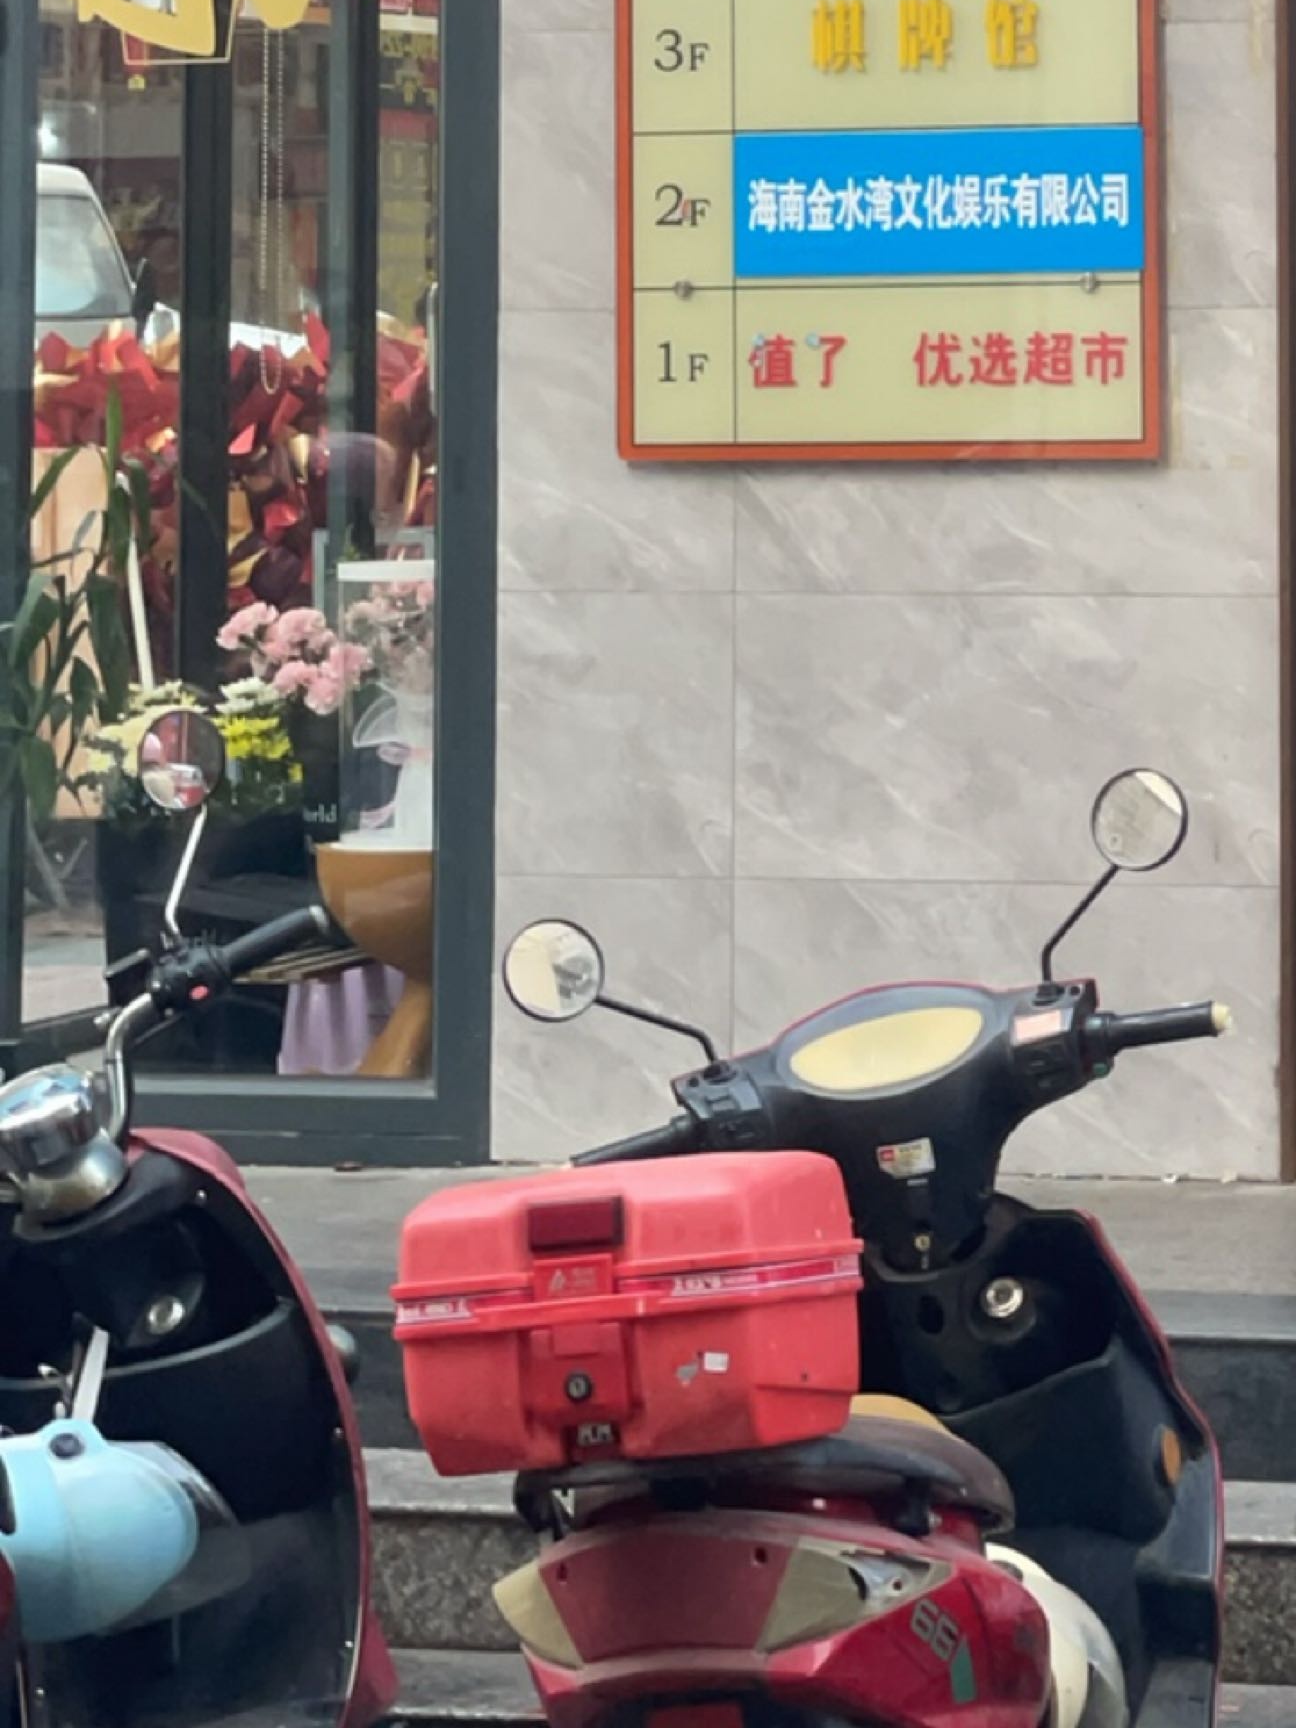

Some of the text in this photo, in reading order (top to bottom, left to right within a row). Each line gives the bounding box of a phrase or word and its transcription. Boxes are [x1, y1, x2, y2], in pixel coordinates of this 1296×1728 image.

[653, 29, 709, 72] 3F
[654, 183, 710, 228] 2F
[747, 172, 1130, 233] 海南金水湾文化娱乐有限公司
[657, 342, 709, 383] 1F
[748, 330, 1130, 389] 值了 优选超市
